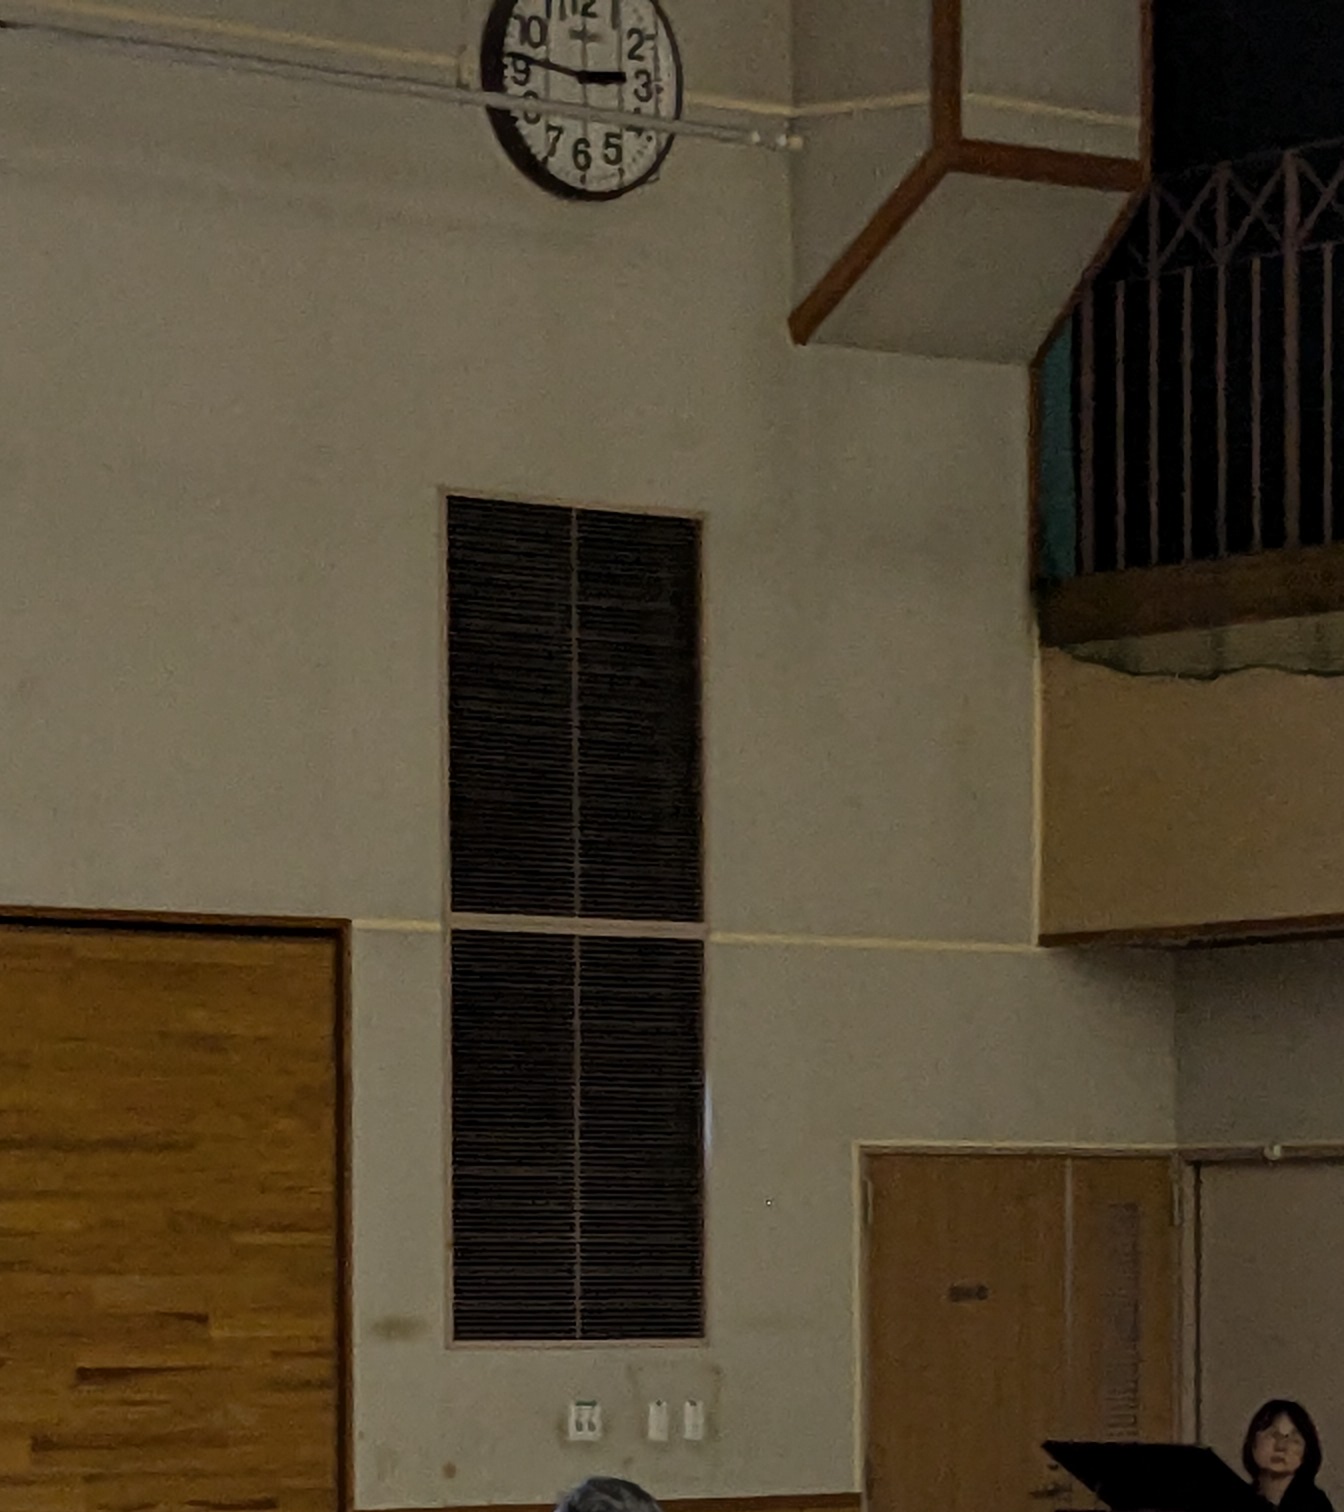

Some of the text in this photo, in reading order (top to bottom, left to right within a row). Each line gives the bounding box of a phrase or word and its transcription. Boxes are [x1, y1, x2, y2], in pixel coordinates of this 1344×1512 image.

[512, 14, 549, 50] 10
[626, 27, 644, 62] 2
[510, 57, 532, 87] 9
[633, 69, 653, 103] 3
[546, 124, 564, 158] 7
[572, 137, 592, 172] 6
[602, 131, 624, 166] 5
